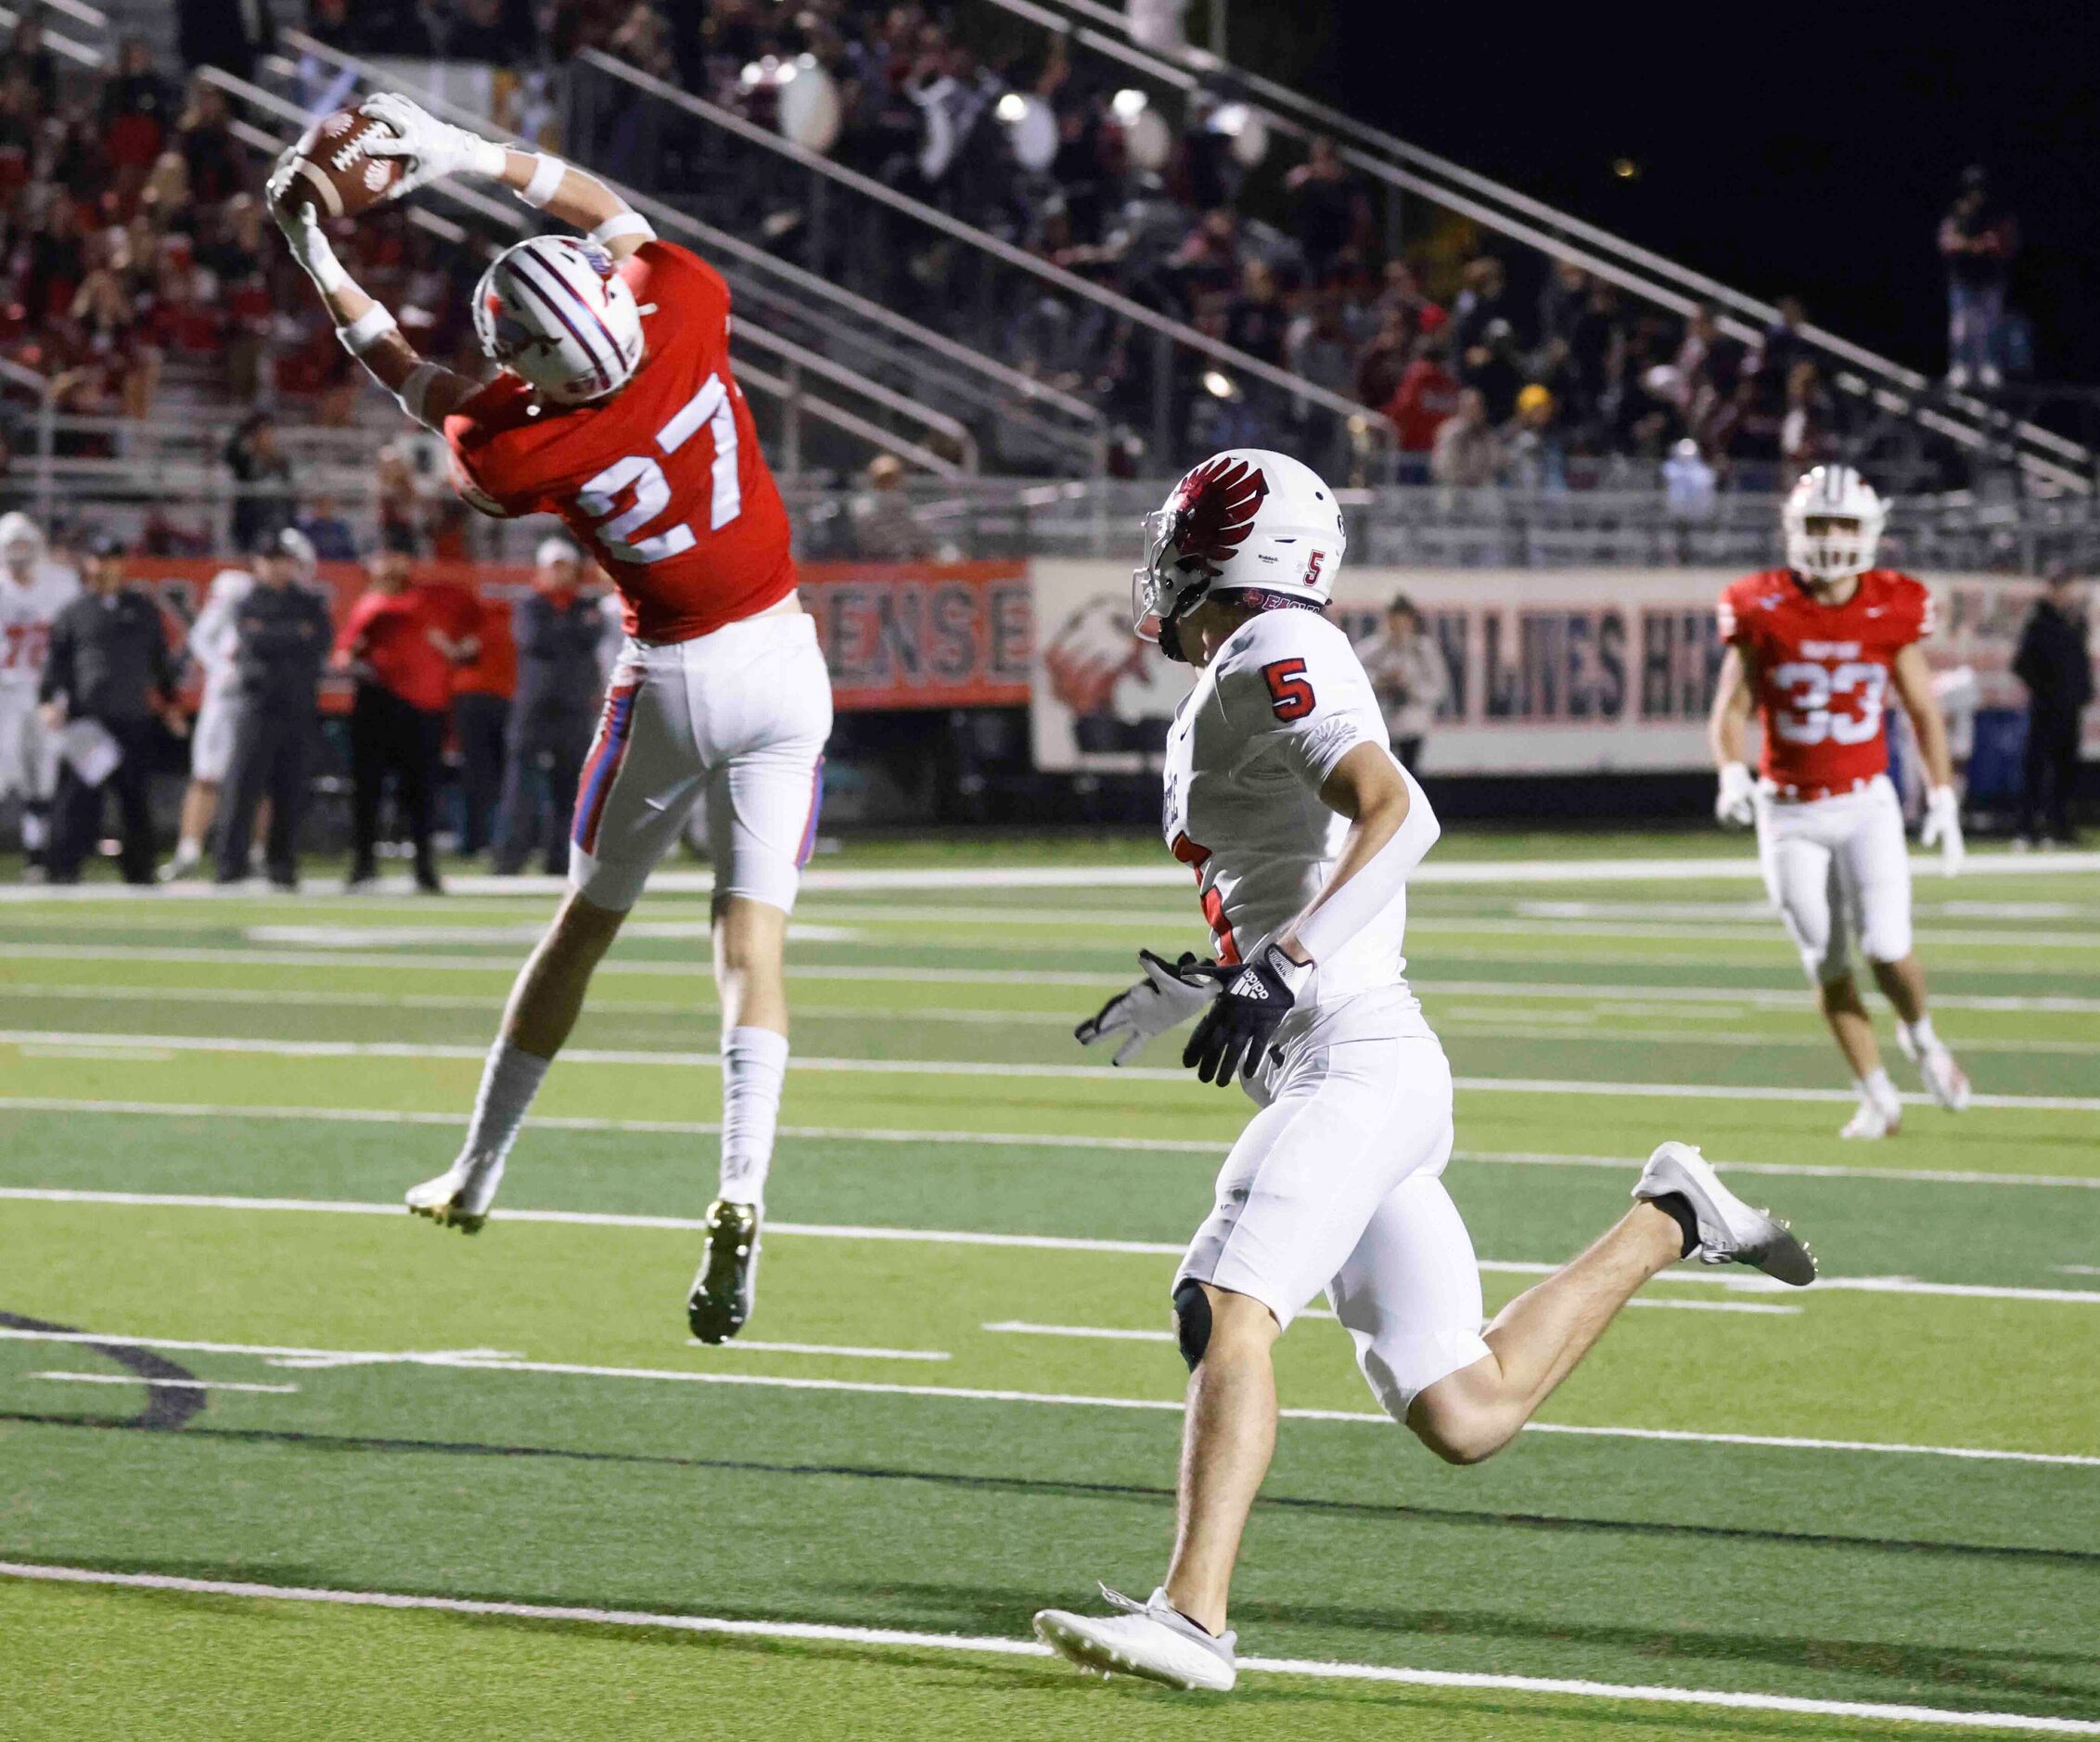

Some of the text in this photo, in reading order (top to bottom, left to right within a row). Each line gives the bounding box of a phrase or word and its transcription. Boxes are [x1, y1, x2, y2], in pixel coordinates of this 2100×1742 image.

[577, 372, 741, 564] 27
[1303, 549, 1325, 587] 5
[800, 582, 1031, 682] ENSE
[1261, 657, 1316, 724] 5
[1775, 661, 1889, 745] 33
